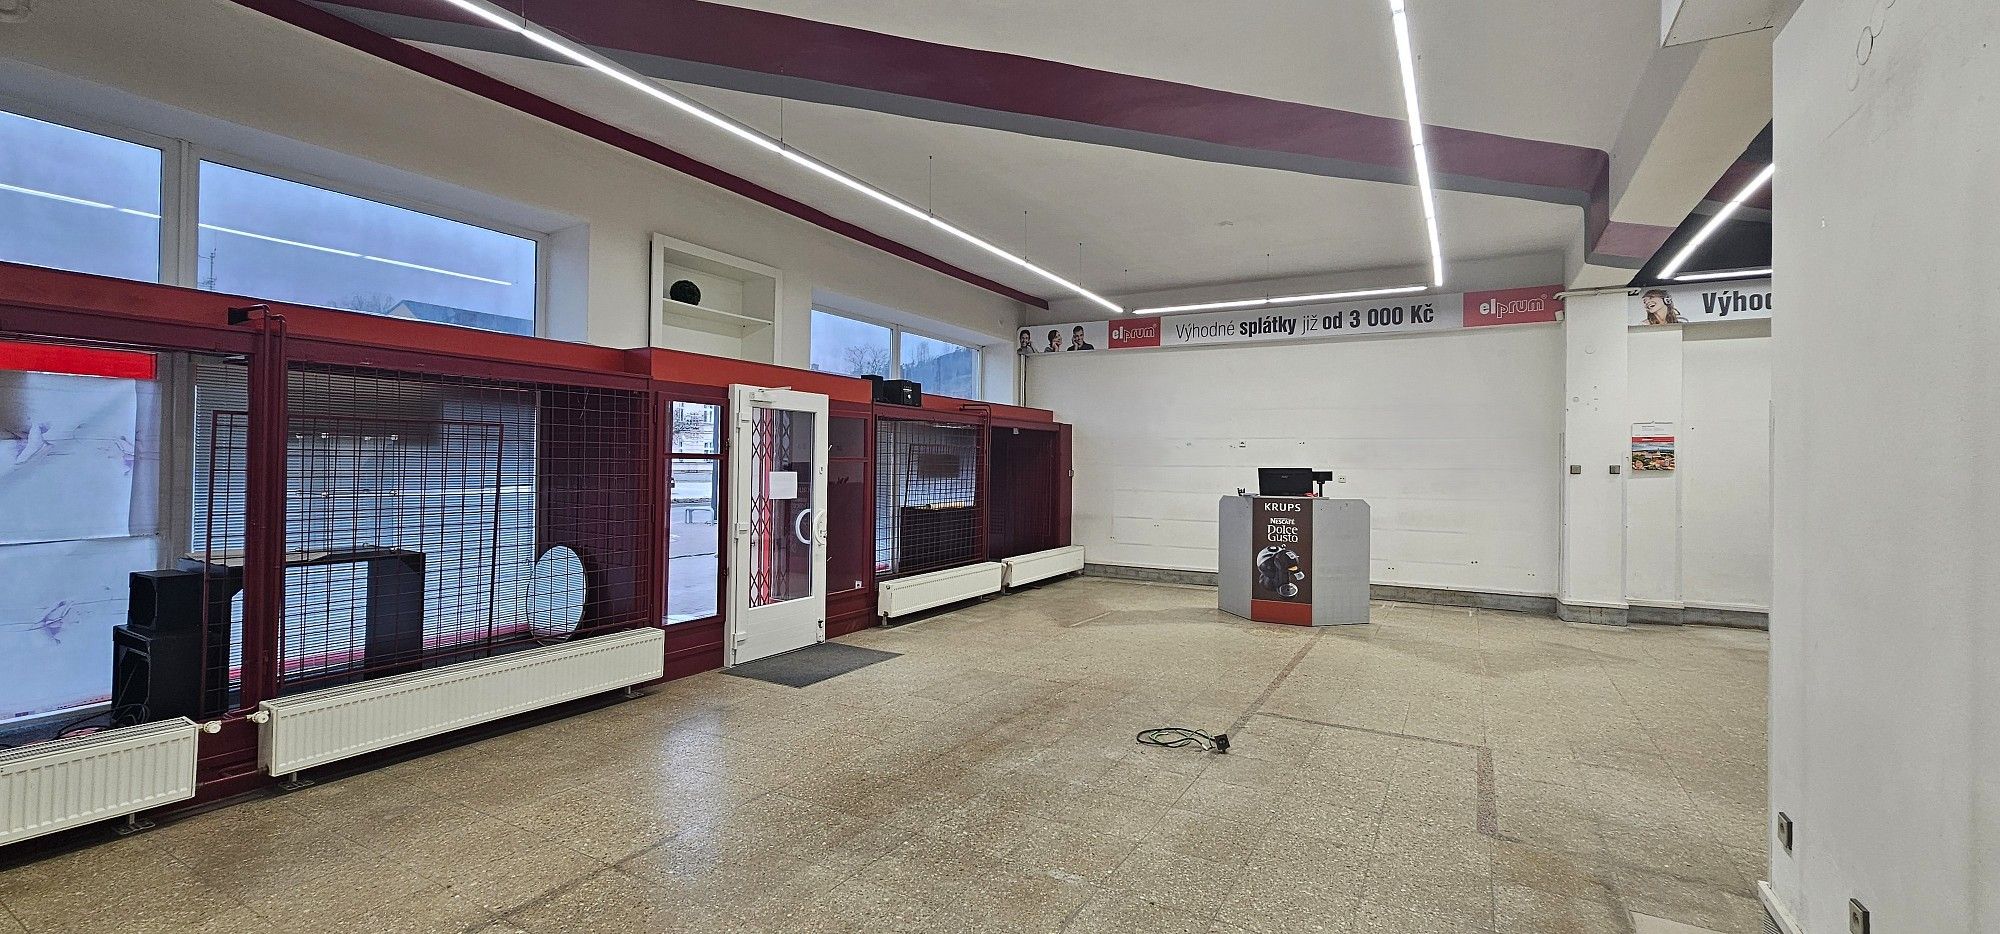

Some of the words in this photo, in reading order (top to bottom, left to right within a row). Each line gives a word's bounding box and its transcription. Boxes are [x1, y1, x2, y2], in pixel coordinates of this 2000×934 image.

[1176, 320, 1235, 342] Výhodné
[1240, 316, 1297, 337] splátky
[1301, 315, 1318, 335] již
[1322, 311, 1343, 329] od
[1349, 310, 1361, 328] 3
[1367, 306, 1404, 326] 000
[1410, 303, 1434, 323] Kč
[1264, 502, 1301, 512] KRUPS
[1267, 524, 1298, 535] Dolce
[1267, 533, 1298, 543] Gusto
